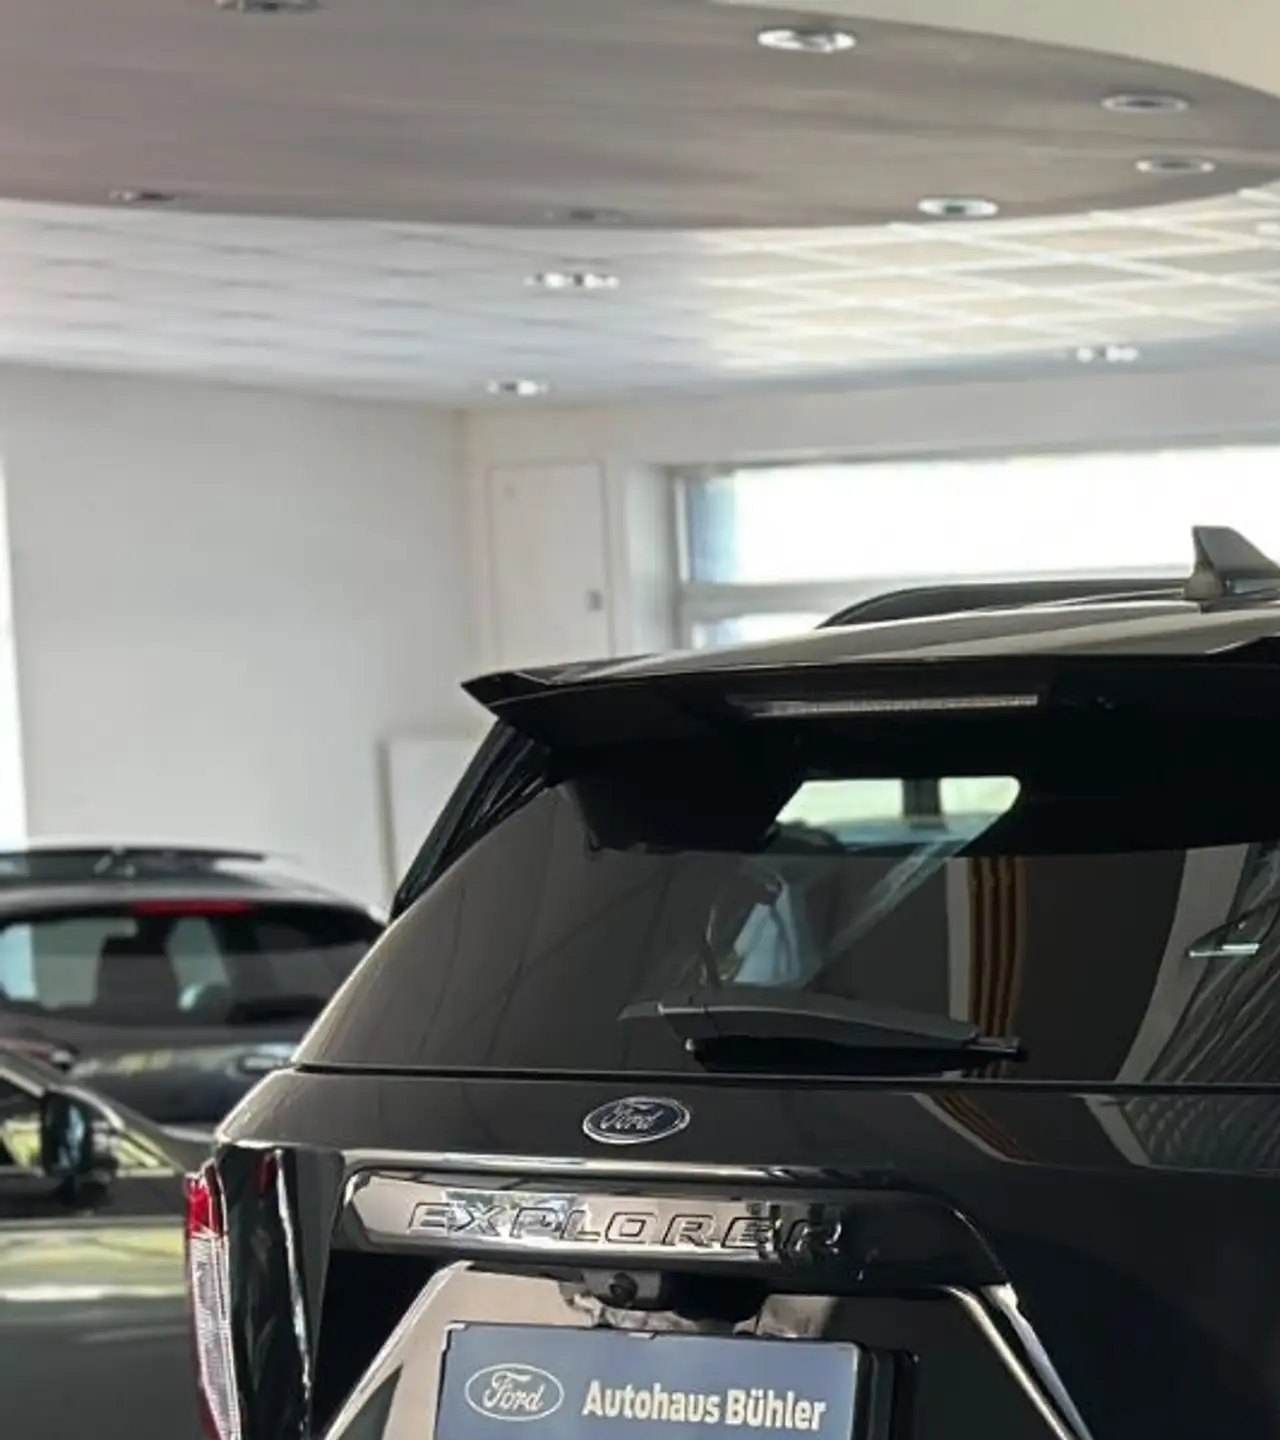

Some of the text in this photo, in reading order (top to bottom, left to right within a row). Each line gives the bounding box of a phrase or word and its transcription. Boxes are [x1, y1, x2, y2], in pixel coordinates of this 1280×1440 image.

[408, 1202, 843, 1257] EXPLORER
[482, 1369, 545, 1414] Ford
[582, 1379, 827, 1431] Autohaus Bühler
